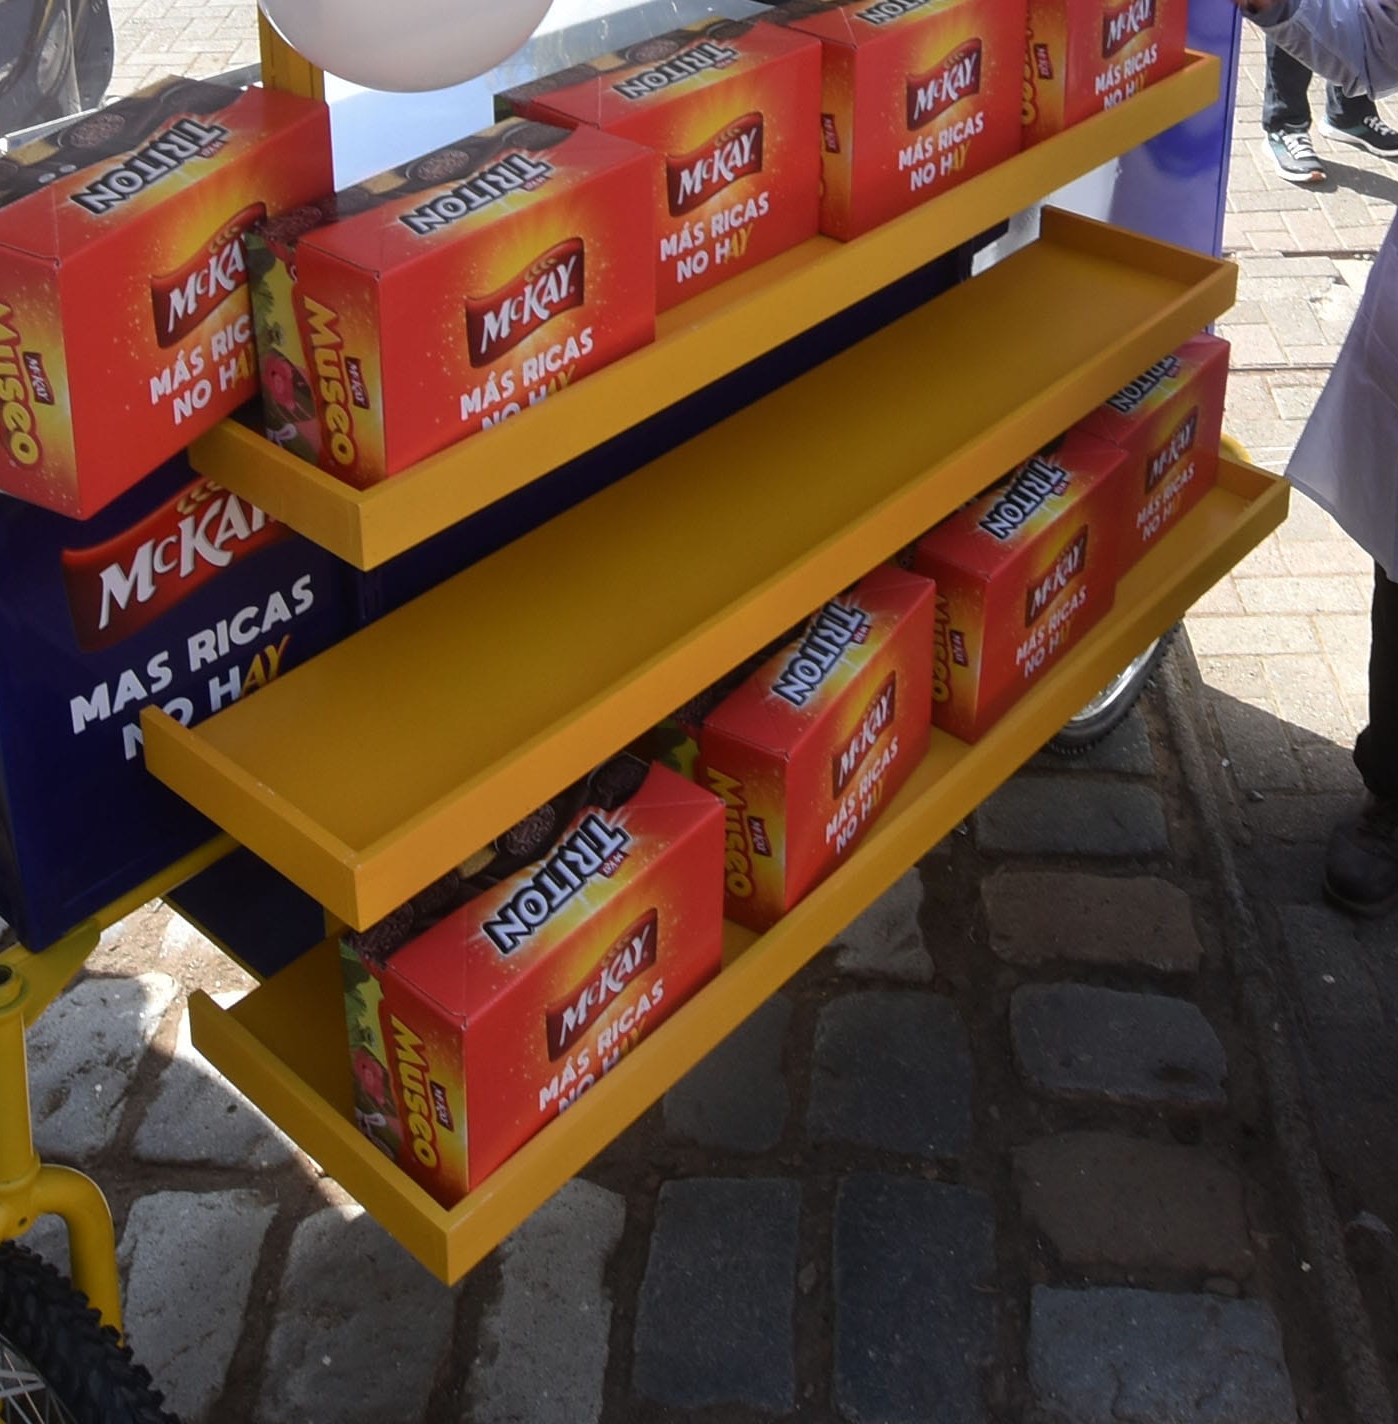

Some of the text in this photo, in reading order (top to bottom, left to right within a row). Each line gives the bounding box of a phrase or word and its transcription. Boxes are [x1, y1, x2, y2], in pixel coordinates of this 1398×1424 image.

[612, 42, 738, 99] TRITON
[1095, 43, 1157, 95] MÁS RICAS
[70, 118, 229, 214] TRITON
[898, 112, 983, 171] MÁS RICAS
[911, 162, 935, 191] NO
[399, 153, 552, 234] TRITON
[661, 191, 768, 261] MÁS RICAS
[168, 234, 245, 333] McKA
[677, 224, 752, 283] NO HAY
[150, 315, 250, 404] MÁS RIC
[173, 342, 253, 425] NO HA
[460, 327, 593, 421] MÁS RICAS
[979, 459, 1066, 539] TRITON
[69, 574, 314, 735] MAS RICAS
[209, 633, 292, 712] HAY
[772, 602, 865, 705] TRITON
[1025, 647, 1045, 678] NO
[860, 736, 898, 800] RICAS
[836, 814, 858, 854] NO
[483, 813, 630, 953] TRITON
[540, 978, 664, 1111] MÁS RICAS
